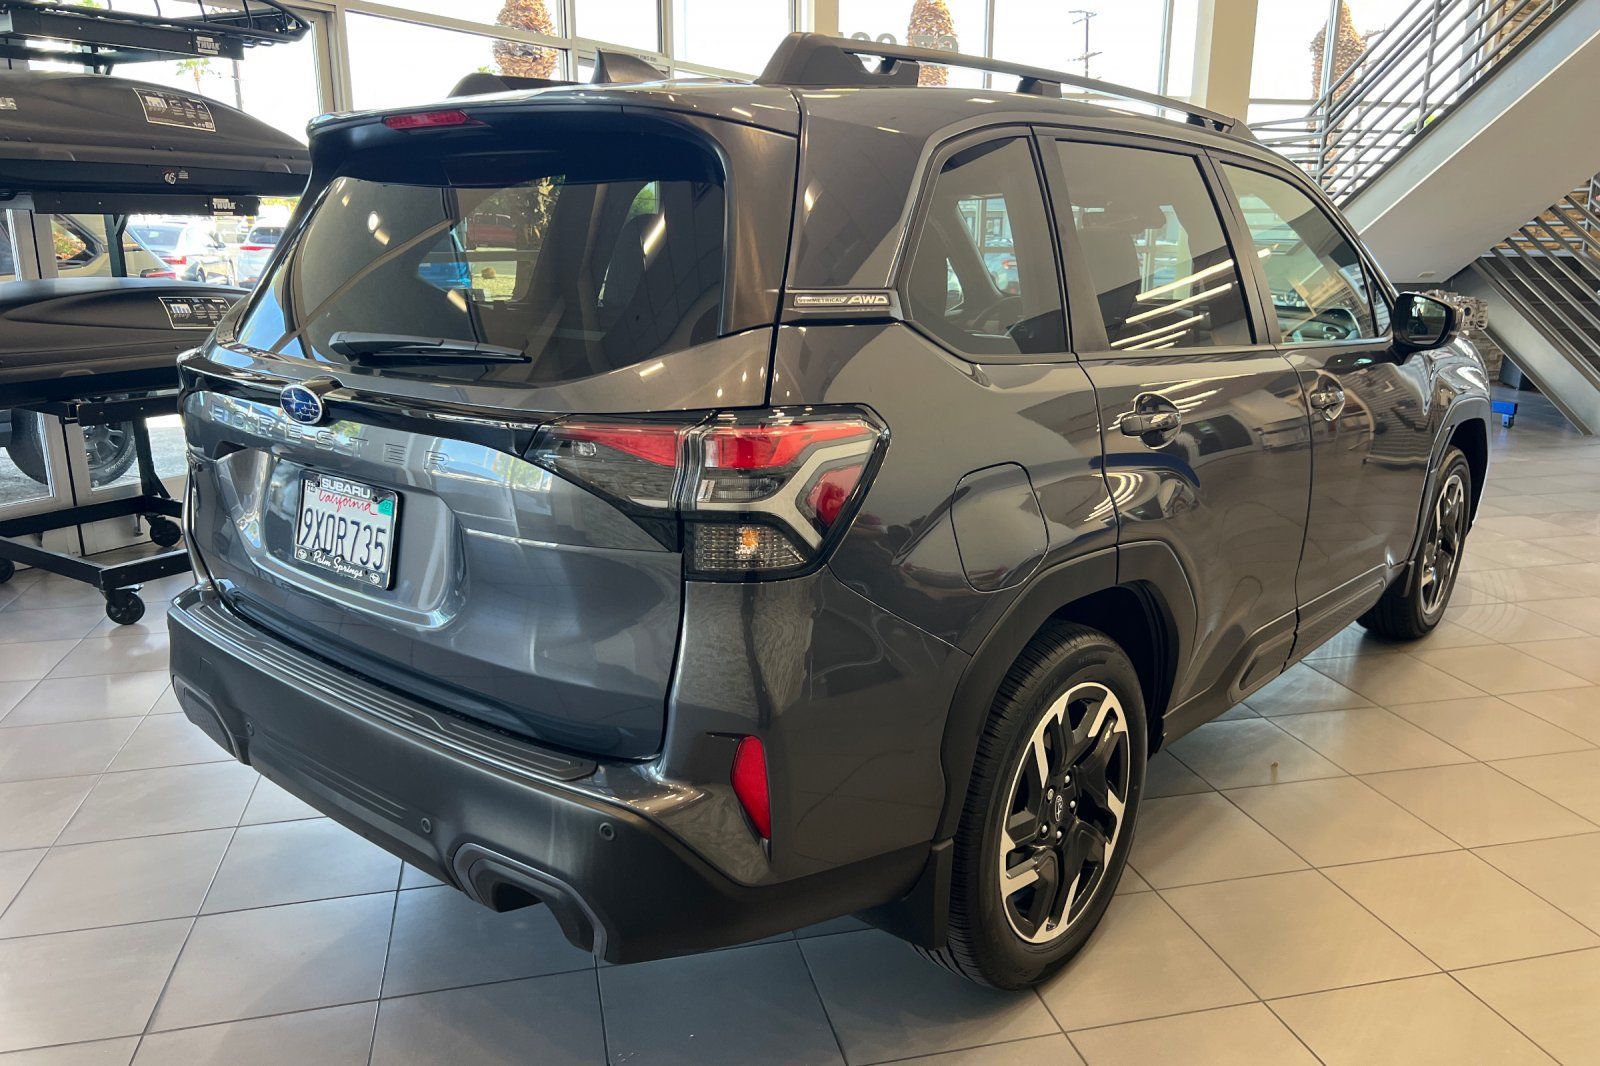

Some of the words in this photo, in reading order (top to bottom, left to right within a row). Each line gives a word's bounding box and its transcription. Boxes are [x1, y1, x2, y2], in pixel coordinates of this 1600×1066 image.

[212, 201, 236, 210] THULE
[848, 295, 888, 304] AWD
[208, 402, 451, 473] FORESTER
[321, 477, 371, 499] SUBARU
[319, 488, 378, 516] California
[312, 550, 332, 568] Palm
[333, 555, 363, 579] Springs
